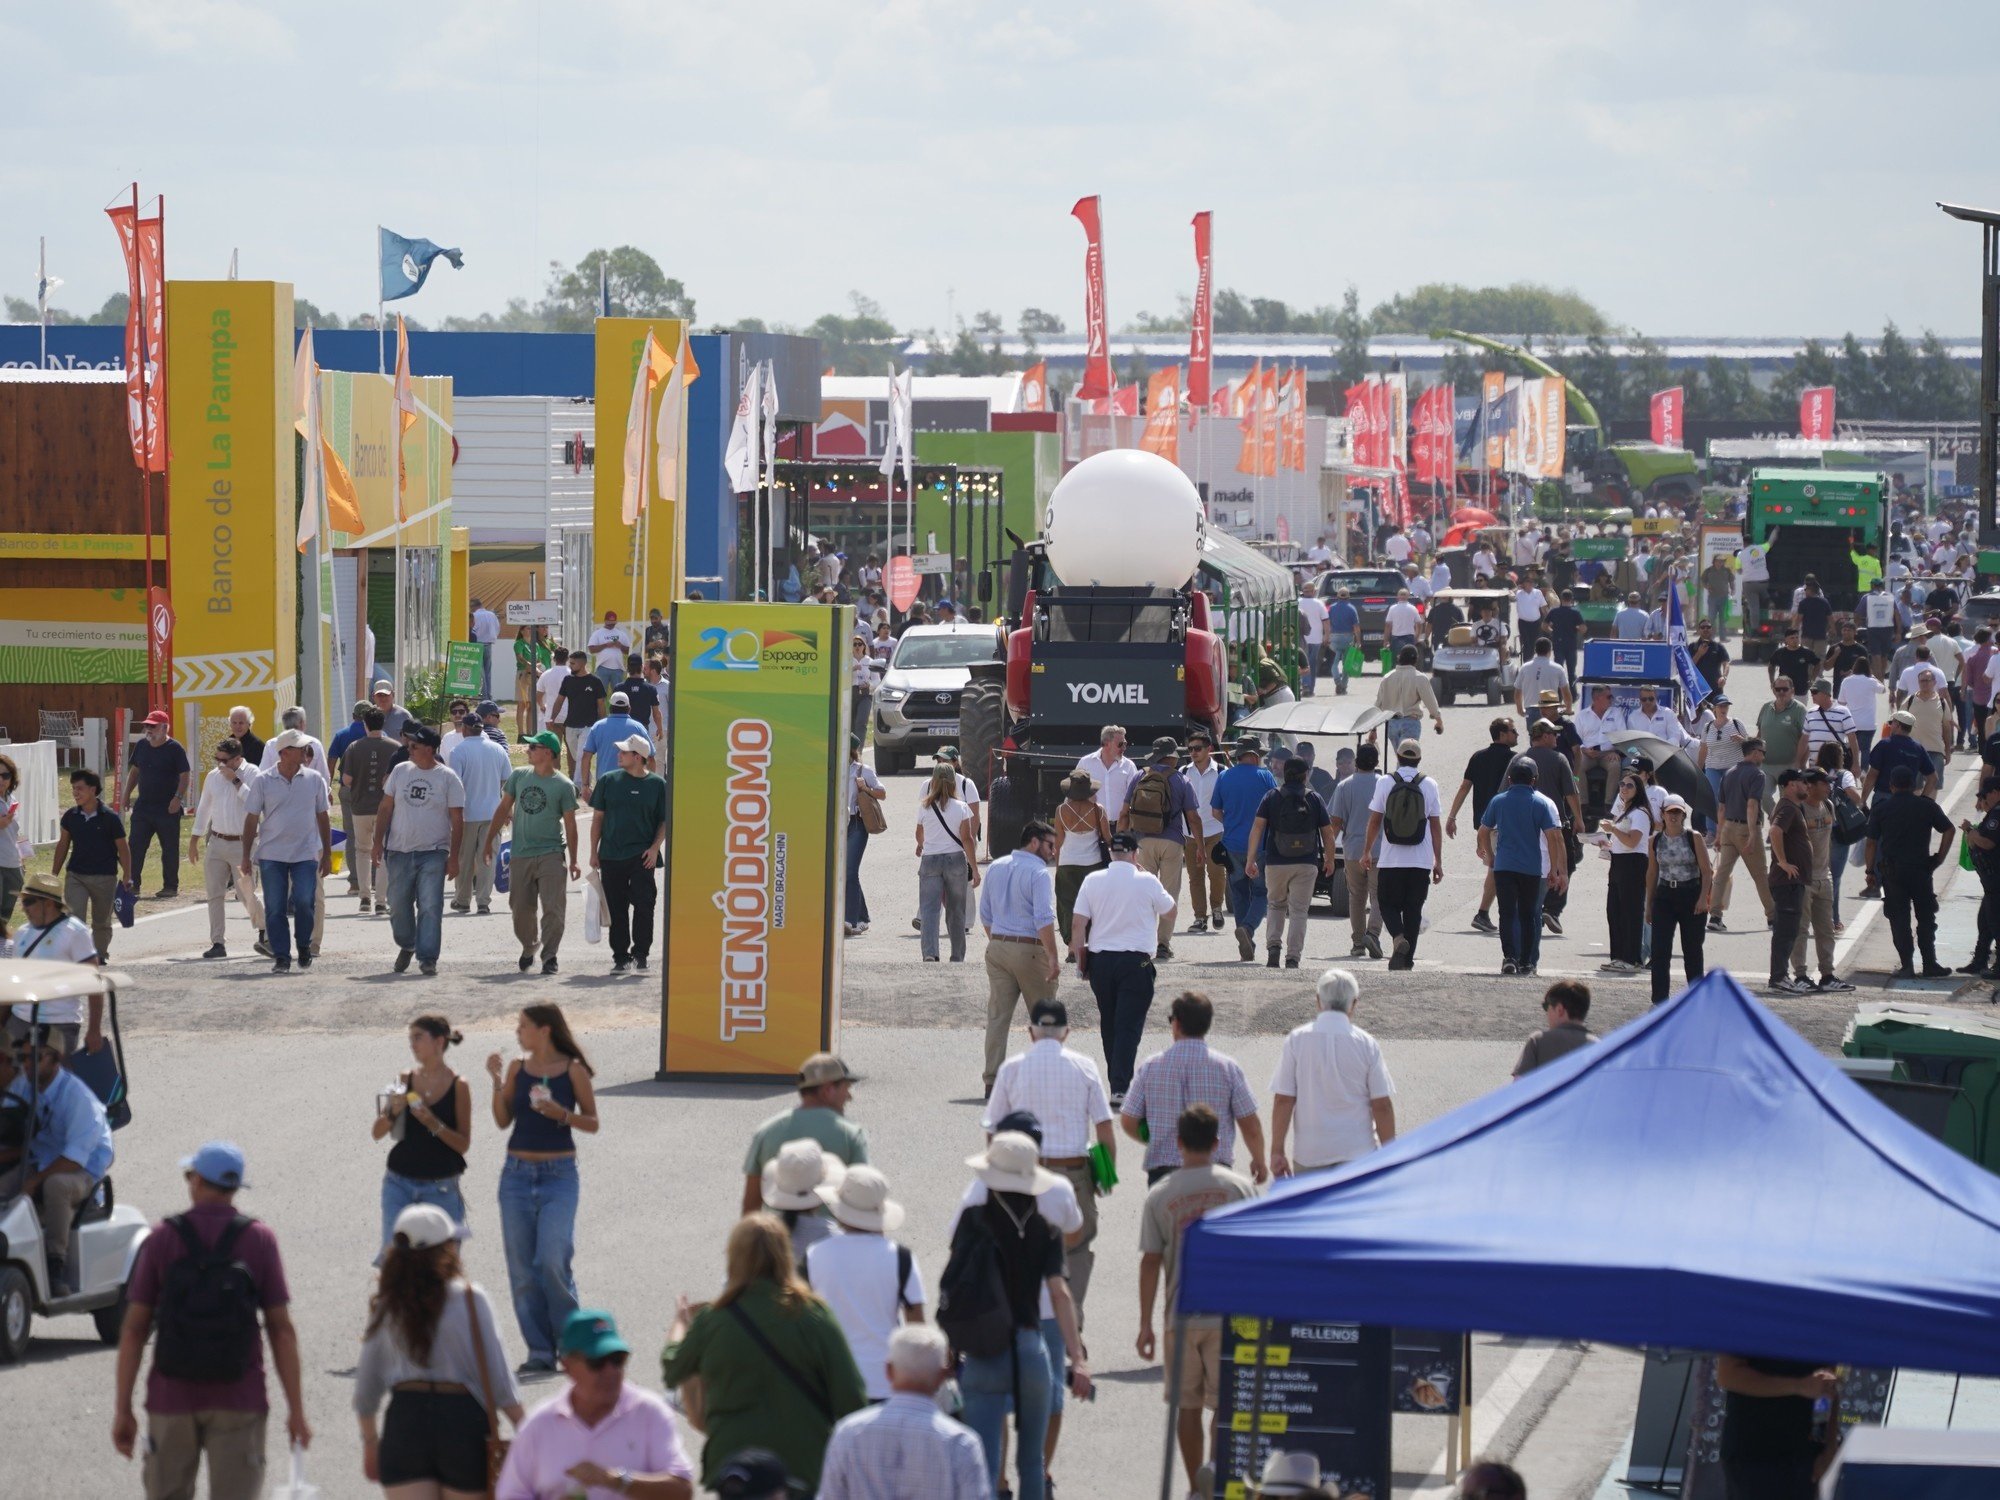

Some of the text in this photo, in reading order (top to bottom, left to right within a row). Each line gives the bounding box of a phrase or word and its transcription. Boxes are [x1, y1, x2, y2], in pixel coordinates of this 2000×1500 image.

[206, 307, 238, 614] Banco de La Pampa
[355, 433, 377, 478] Banco
[379, 428, 387, 477] de
[1215, 488, 1254, 503] made
[1215, 509, 1228, 523] in
[1644, 520, 1660, 530] CAT
[0, 538, 134, 552] Banco de La Pampa
[26, 629, 39, 639] Tu
[42, 630, 102, 640] crecimiento
[105, 633, 116, 641] es
[689, 626, 760, 671] 20
[762, 650, 818, 664] Expoagro
[795, 666, 818, 675] agro
[1066, 682, 1149, 704] YOMEL
[410, 786, 427, 800] DC
[713, 720, 771, 1040] TECNÓDROMO
[774, 834, 787, 928] MARIO BRAGACHINI
[1291, 1327, 1359, 1342] RELLENOS
